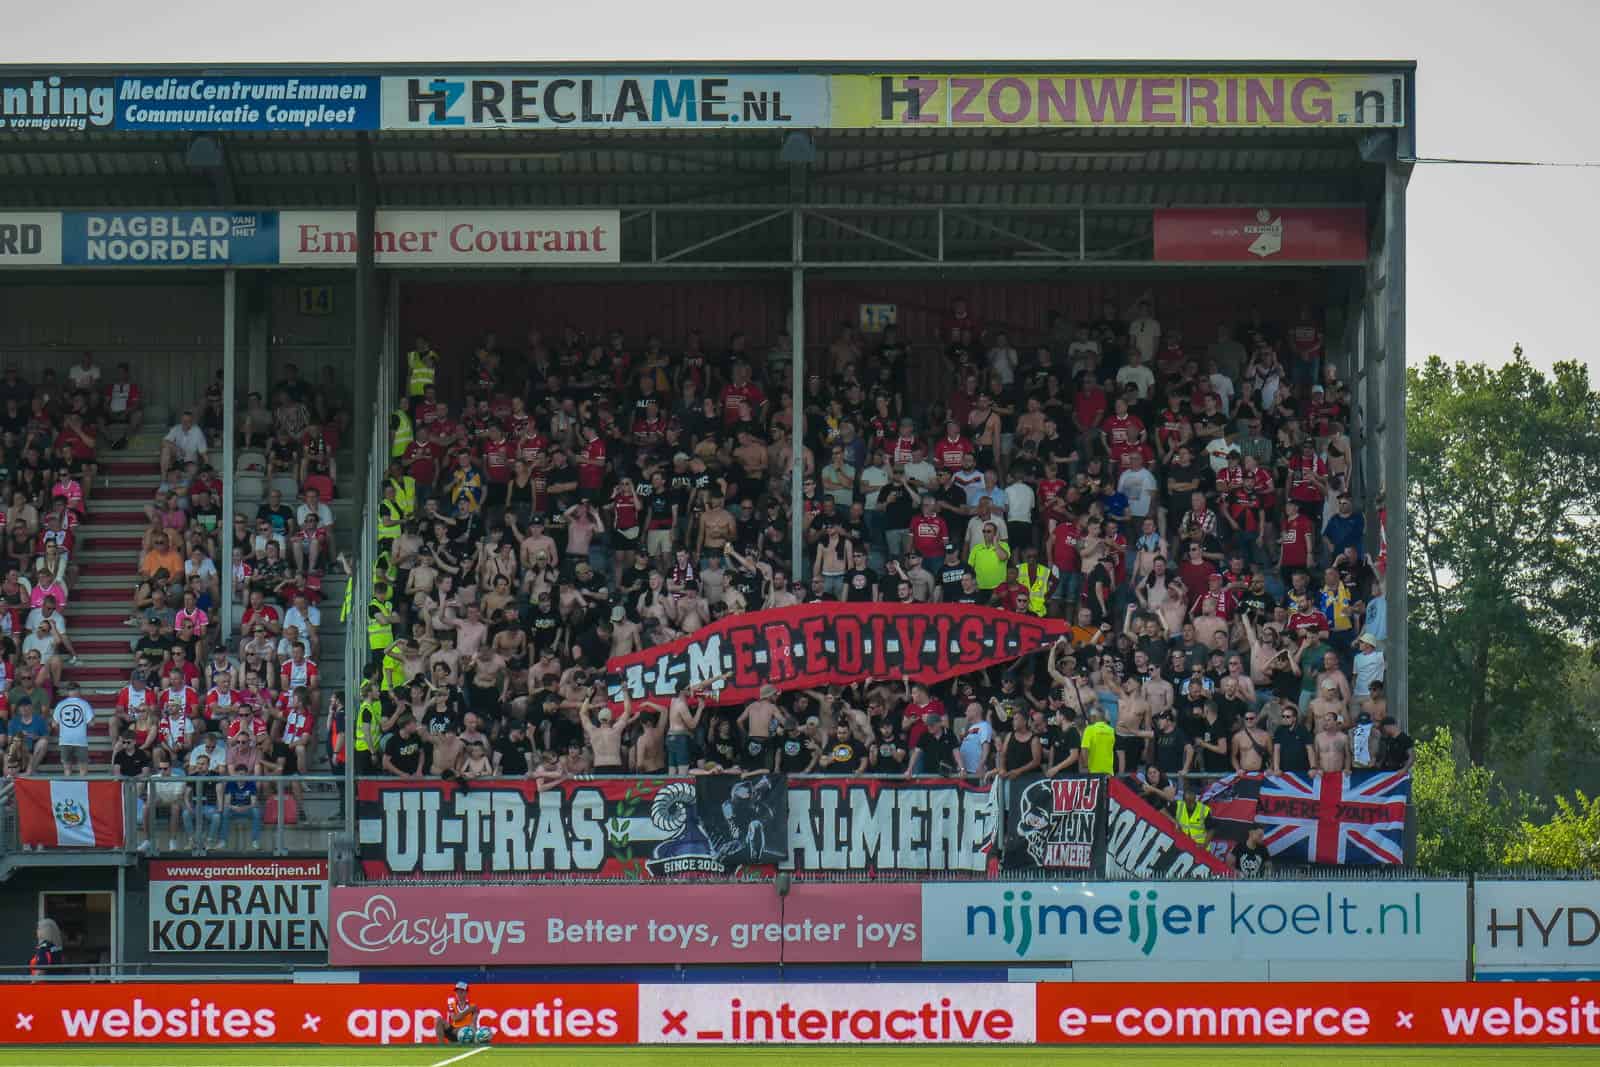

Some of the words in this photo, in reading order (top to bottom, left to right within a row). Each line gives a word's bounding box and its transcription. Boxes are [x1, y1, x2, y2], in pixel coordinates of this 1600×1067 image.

[120, 78, 367, 101] MediaCentrumEmmen
[125, 105, 260, 123] Communicatie
[266, 105, 356, 127] Compleet
[87, 216, 230, 238] DAGBLAD
[231, 215, 252, 226] VAN
[87, 240, 230, 260] NOORDEN
[449, 223, 608, 253] Courant
[1051, 778, 1100, 813] WIJ
[1257, 798, 1321, 819] ALMERE
[381, 790, 605, 872] ULTRAS
[779, 787, 997, 871] ALMERE
[1047, 812, 1096, 845] ZIJN
[664, 859, 697, 873] SINCE
[1044, 844, 1092, 867] ALMERE
[167, 863, 321, 879] www.garantkozijnen.nl
[164, 884, 322, 915] GARANT
[152, 919, 329, 951] KOZIJNEN
[547, 918, 633, 944] Better
[648, 919, 719, 949] toys,
[731, 919, 846, 949] greater
[856, 914, 916, 949] joys
[1487, 907, 1600, 948] HYD
[61, 998, 276, 1037] websites
[347, 998, 619, 1044] appcaties
[1058, 1005, 1370, 1036] e-commerce
